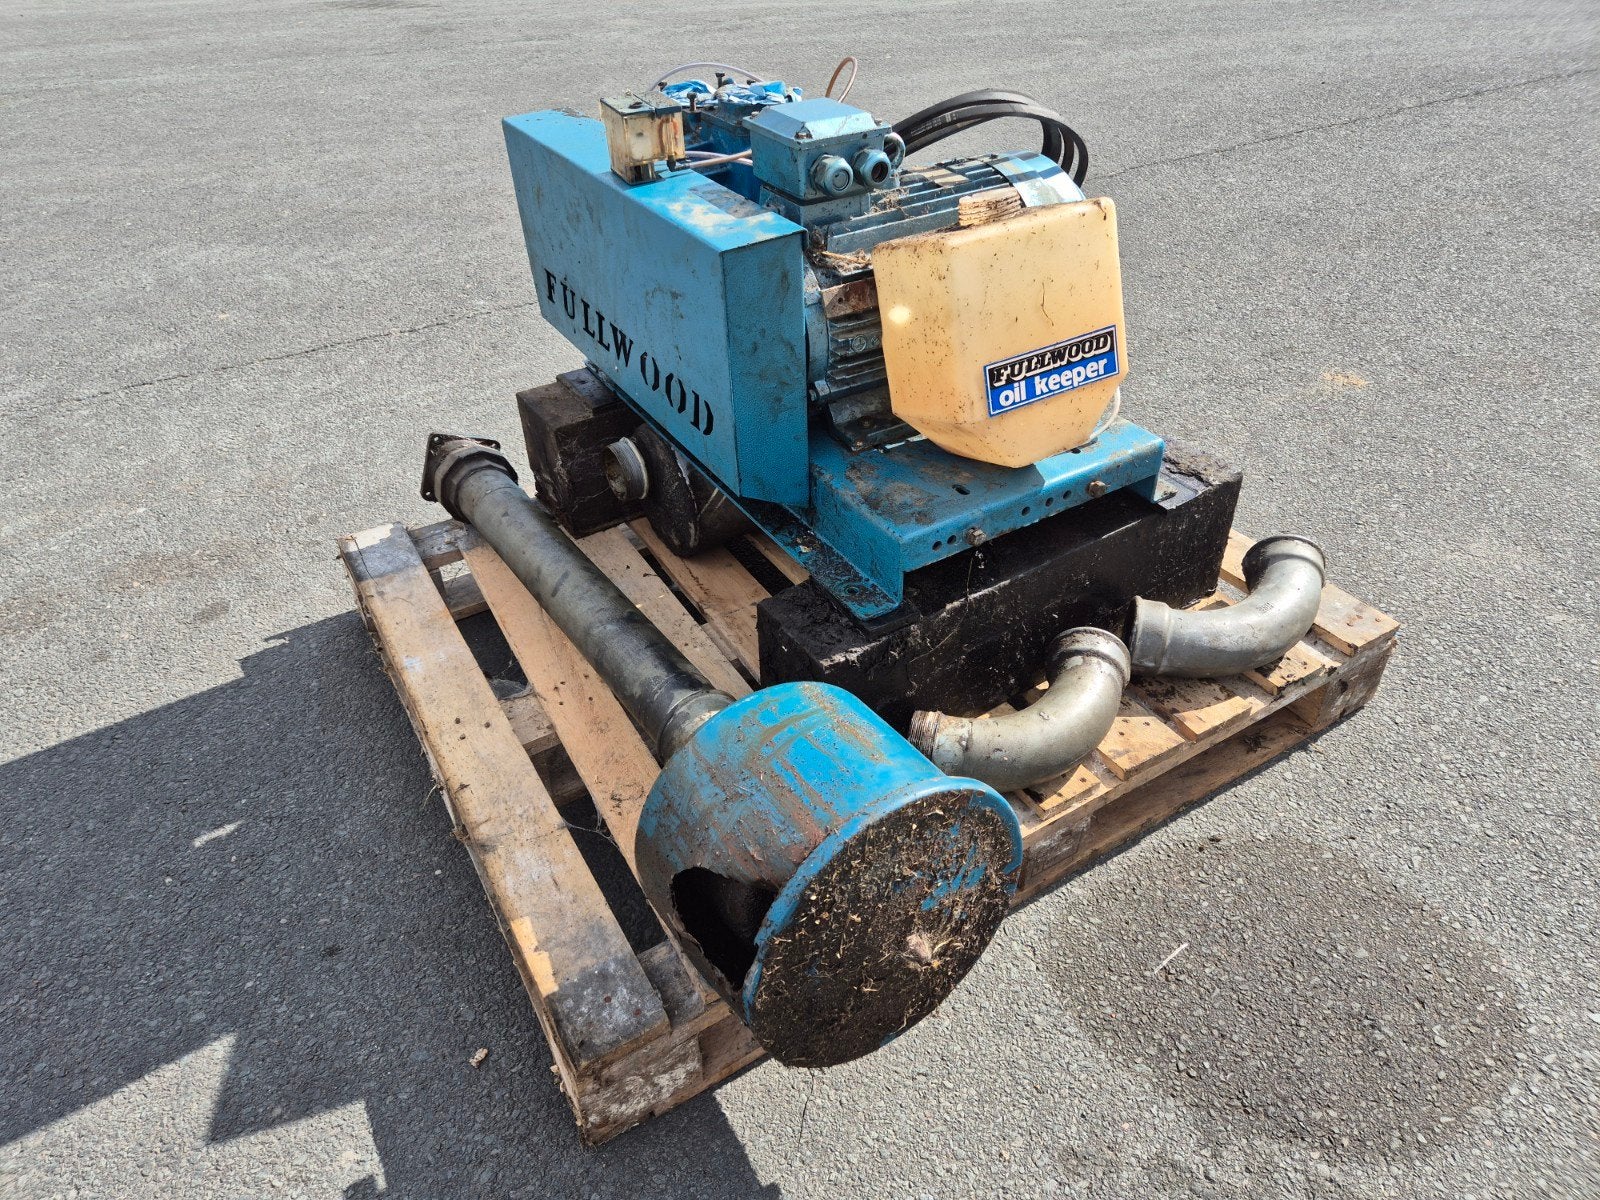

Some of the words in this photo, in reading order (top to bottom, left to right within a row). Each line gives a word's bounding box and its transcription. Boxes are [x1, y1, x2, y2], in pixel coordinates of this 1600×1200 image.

[544, 268, 714, 436] FULLWOOD
[993, 333, 1111, 387] FULLWOOD
[999, 378, 1027, 407] oil
[1034, 358, 1108, 396] keeper
